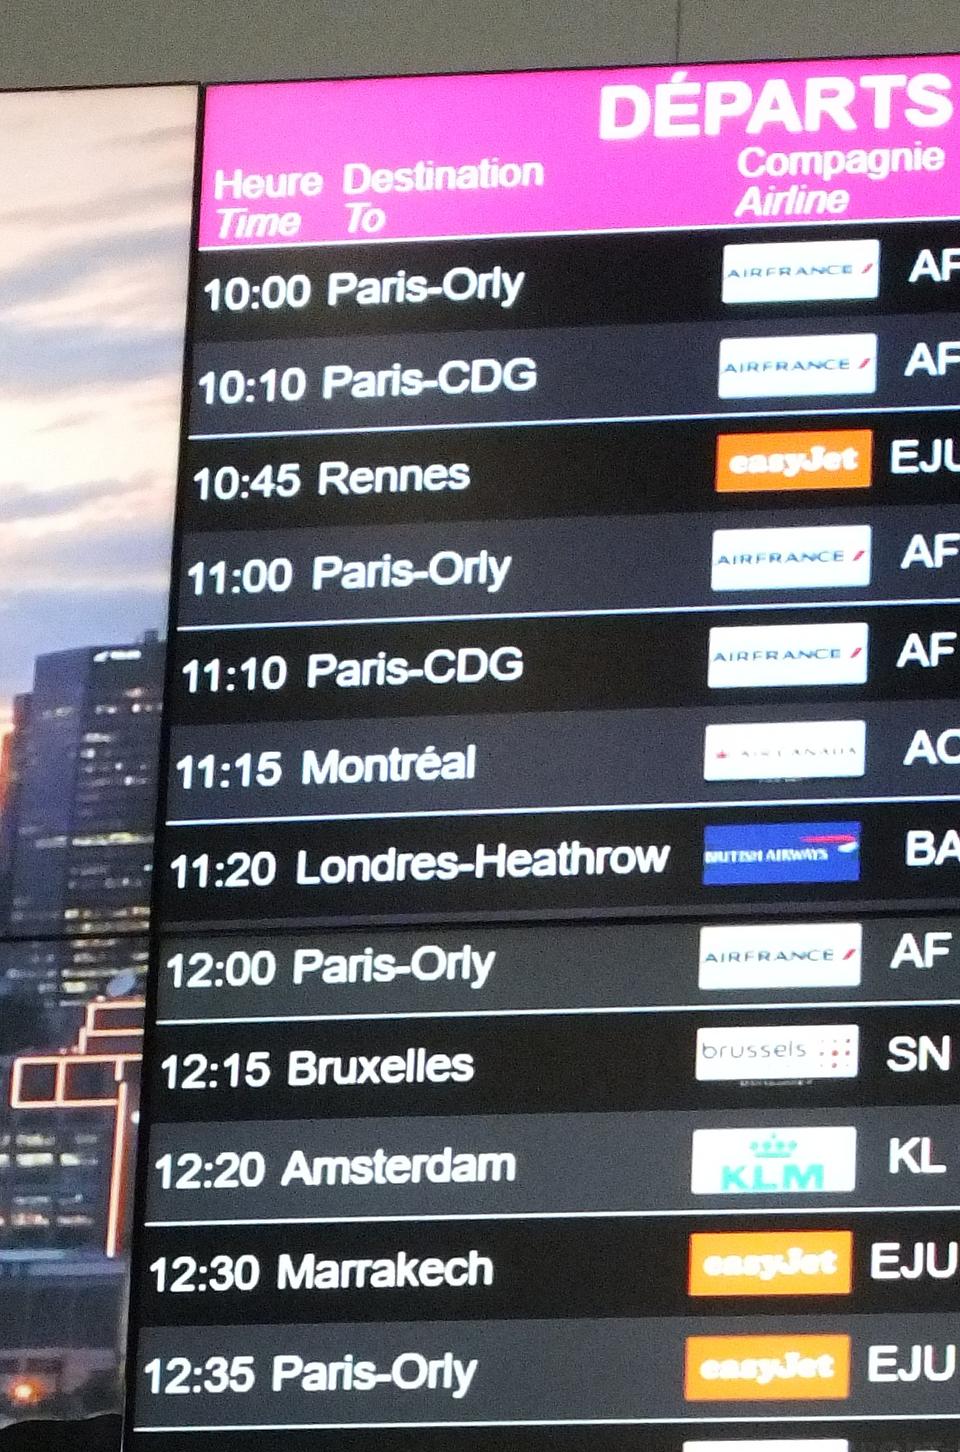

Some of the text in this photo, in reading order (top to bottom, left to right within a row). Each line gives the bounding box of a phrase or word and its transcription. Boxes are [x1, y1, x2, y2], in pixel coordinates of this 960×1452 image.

[599, 73, 954, 142] DÉPARTS
[343, 158, 544, 195] Destination
[738, 142, 946, 181] Compagnie
[215, 168, 323, 199] Heure
[736, 185, 850, 219] Airline
[217, 209, 301, 238] Time
[347, 205, 386, 234] To
[204, 274, 312, 312] 10:00
[327, 265, 526, 308] Paris-Orly
[198, 366, 307, 405] 10:10
[322, 357, 537, 400] Paris-CDG
[318, 461, 471, 496] Rennes
[728, 444, 859, 478] easyJet
[193, 462, 301, 501] 10:45
[187, 557, 293, 596] 11:00
[312, 549, 513, 593] Paris-Orly
[307, 646, 524, 689] Paris-CDG
[896, 631, 958, 668] AF
[182, 655, 288, 693] 11:10
[176, 751, 283, 790] 11:15
[301, 743, 477, 785] Montréal
[170, 851, 277, 889] 11:20
[296, 840, 671, 885] Londres-Heathrow
[166, 950, 277, 988] 12:00
[293, 944, 497, 990] Paris-Orly
[287, 1047, 475, 1086] Bruxelles
[701, 1040, 807, 1060] brussels
[886, 1035, 951, 1072] SN
[161, 1051, 271, 1090] 12:15
[155, 1151, 266, 1190] 12:20
[280, 1146, 517, 1187] Amsterdam
[720, 1163, 825, 1191] KLM
[149, 1254, 260, 1293] 12:30
[277, 1249, 494, 1290] Marrakech
[702, 1246, 838, 1281] easyJet
[870, 1241, 958, 1280] EJU
[144, 1355, 256, 1394] 12:35
[272, 1351, 479, 1399] Paris-Orly
